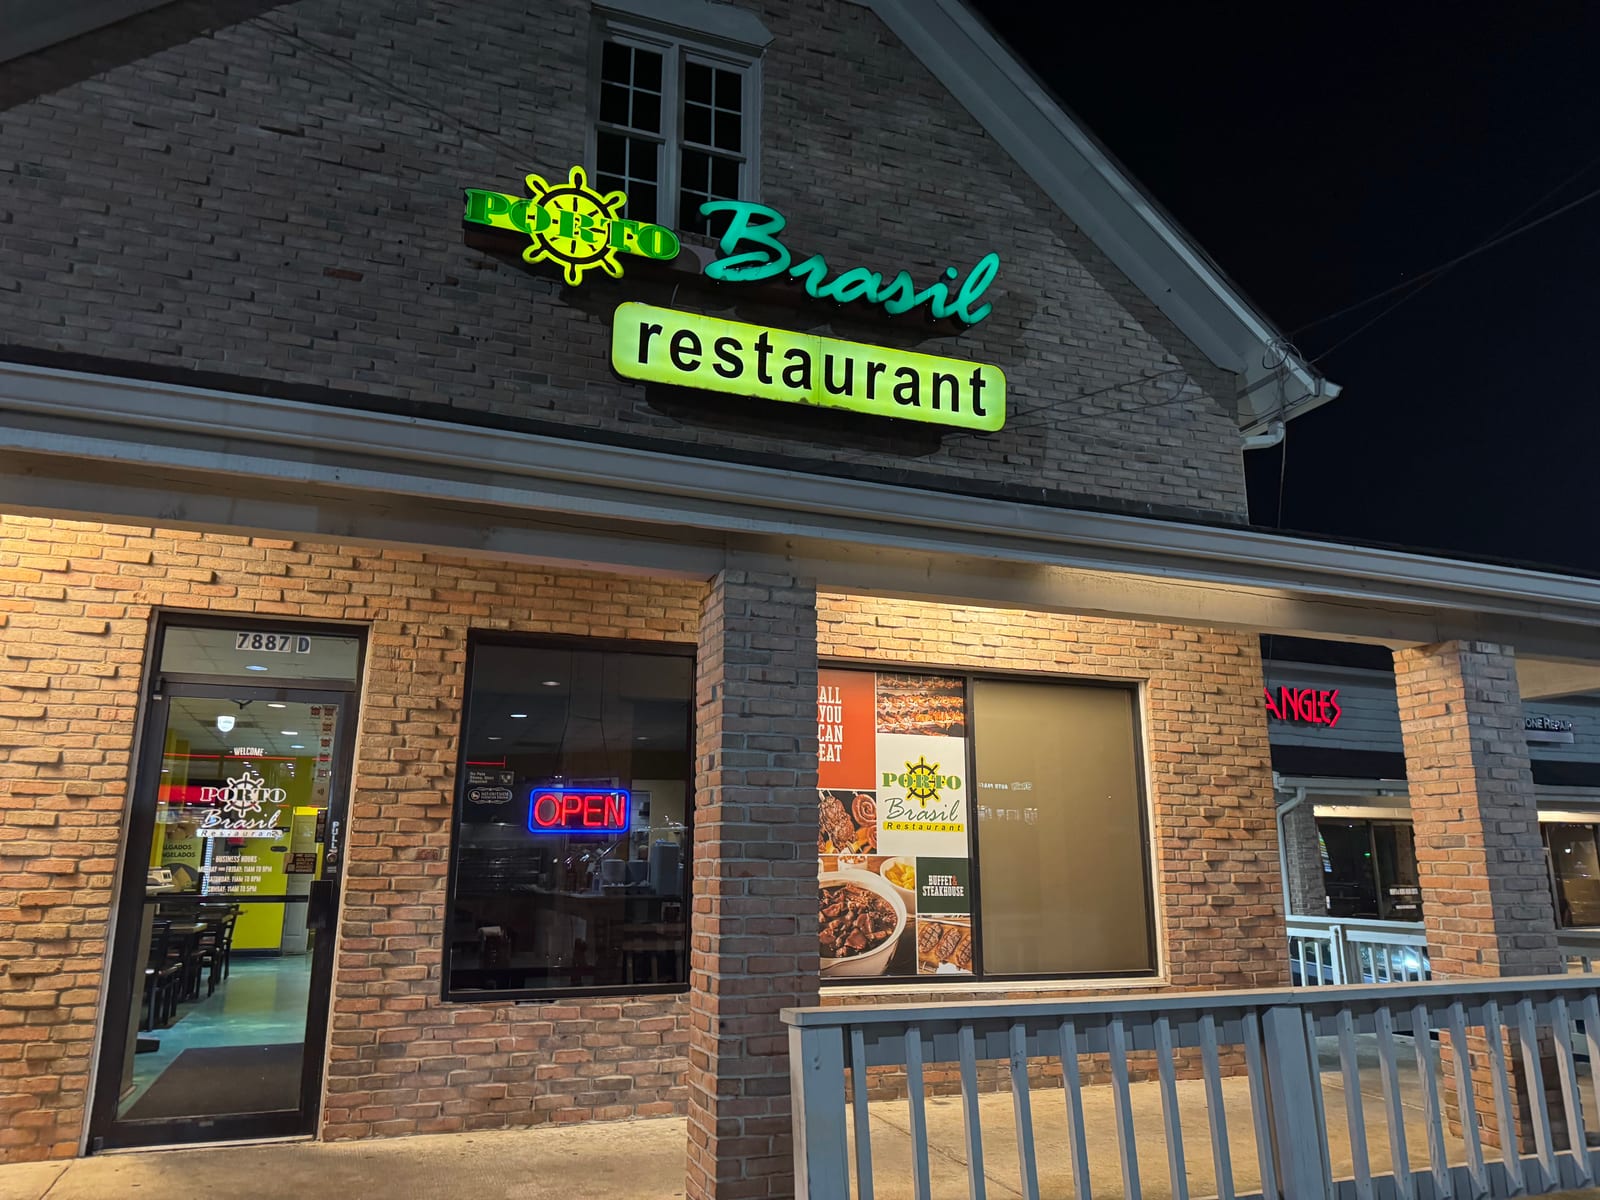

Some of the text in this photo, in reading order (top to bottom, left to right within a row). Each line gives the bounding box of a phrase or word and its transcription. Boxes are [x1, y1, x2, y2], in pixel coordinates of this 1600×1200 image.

[463, 189, 1000, 324] PORTO Brasil
[637, 321, 987, 417] restaurant
[237, 633, 310, 652] 7887 D
[819, 685, 842, 704] ALL
[819, 704, 842, 723] YOU
[817, 723, 844, 743] CAN
[233, 746, 265, 757] WELCOME
[818, 743, 843, 762] EAT
[881, 772, 962, 790] PORTO
[199, 786, 287, 803] PORTO
[201, 808, 282, 829] Brasil
[534, 794, 626, 827] OPEN
[884, 797, 961, 822] Brasil
[331, 821, 340, 849] PULL
[886, 821, 962, 833] Restaurant
[922, 886, 965, 897] STEAKHOUSE
